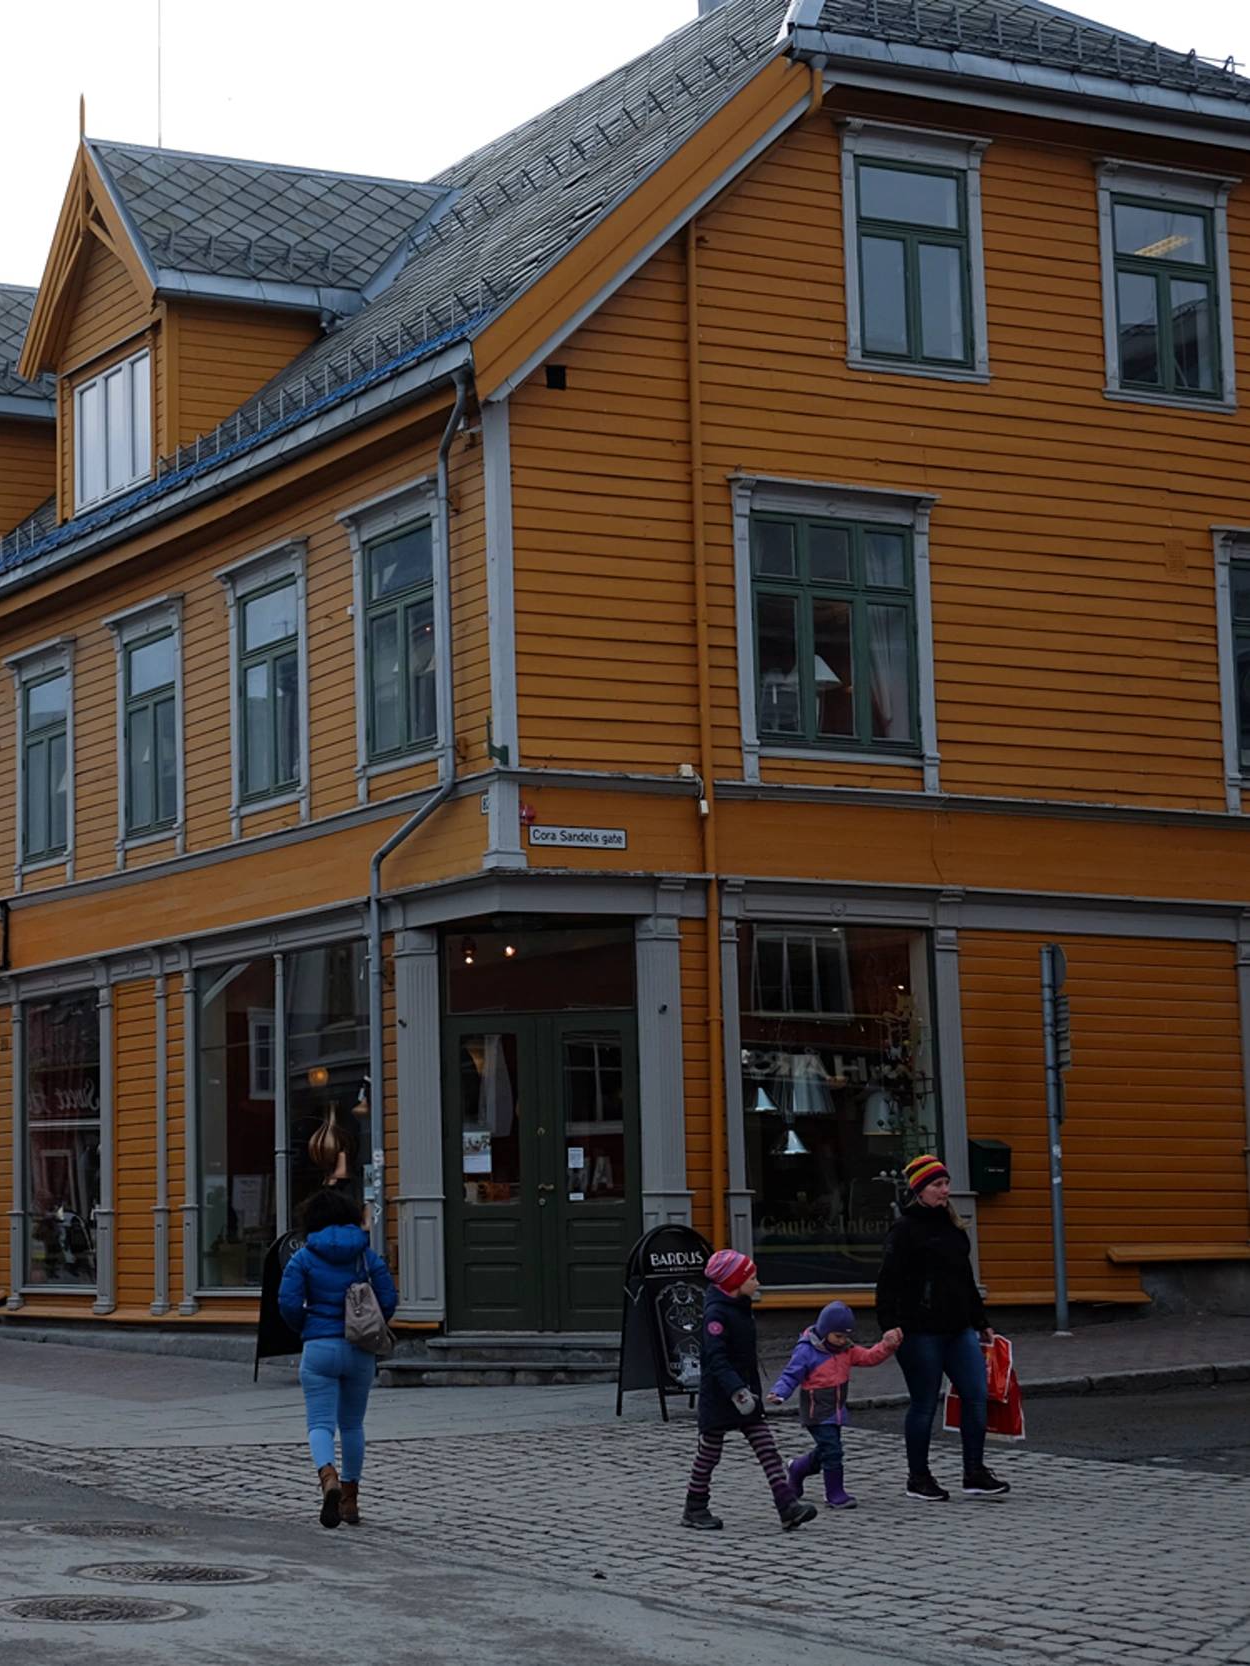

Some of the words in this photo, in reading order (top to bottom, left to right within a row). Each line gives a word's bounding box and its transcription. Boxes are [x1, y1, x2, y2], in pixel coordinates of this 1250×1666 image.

[532, 828, 558, 841] Cora
[559, 830, 600, 843] Sandels
[601, 833, 623, 845] gate
[649, 1250, 705, 1268] BARDUS
